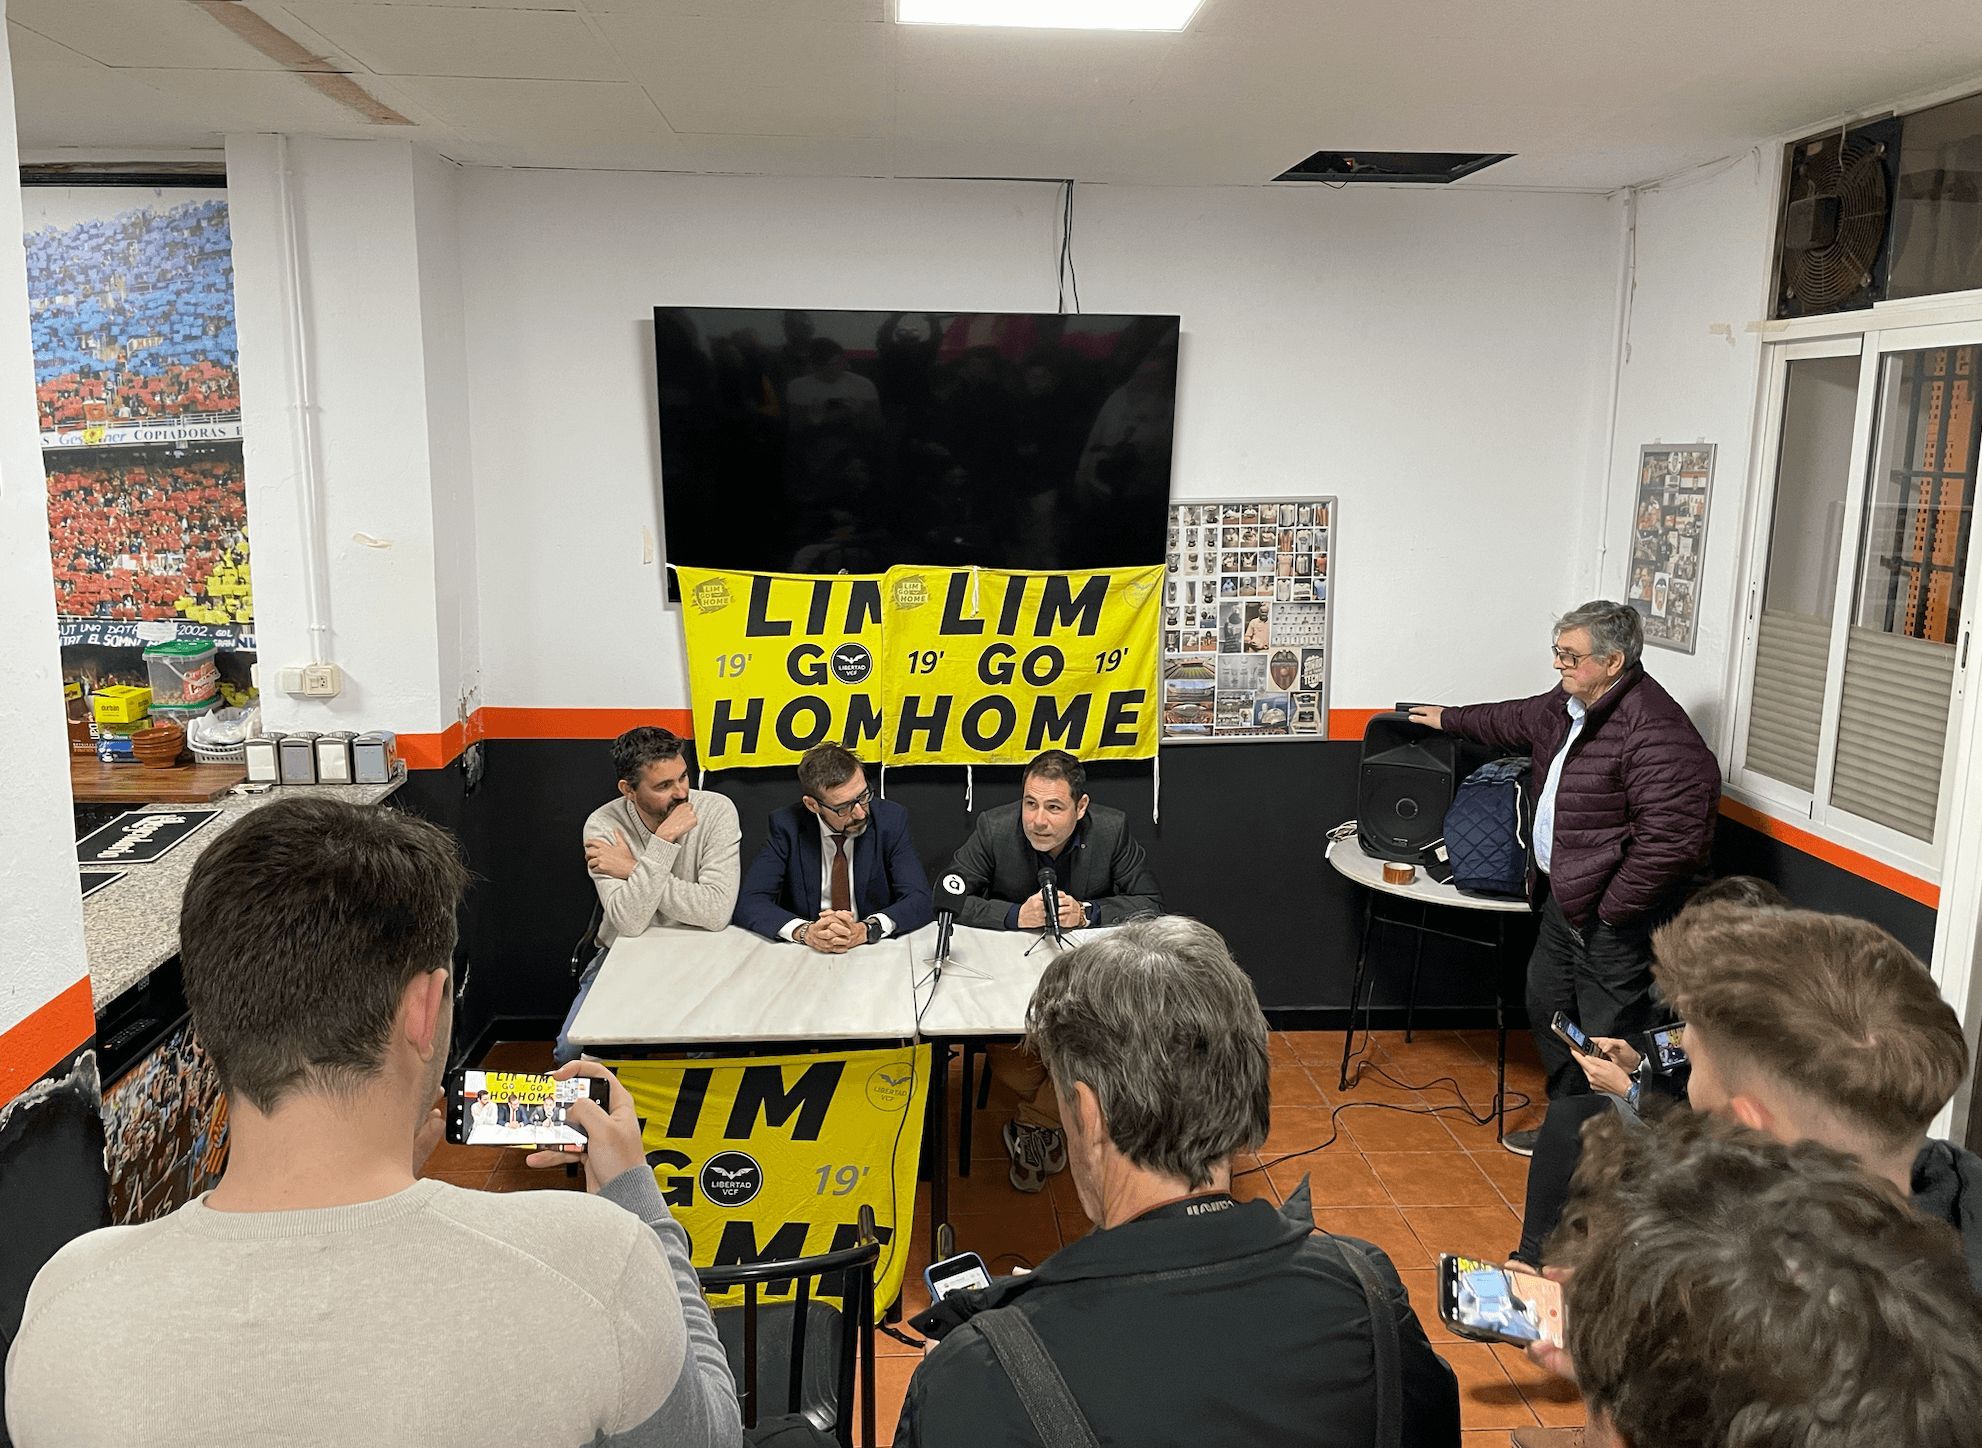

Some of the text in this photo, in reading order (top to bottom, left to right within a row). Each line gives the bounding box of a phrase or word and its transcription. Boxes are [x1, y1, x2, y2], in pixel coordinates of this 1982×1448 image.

[133, 428, 227, 442] COPIADORAS
[940, 573, 1111, 636] LIM
[716, 653, 753, 678] 19'
[908, 642, 1129, 686] 19' GO 19'
[709, 694, 882, 757] HOM
[895, 689, 1146, 754] HOME
[642, 1061, 847, 1142] IM
[873, 1086, 908, 1097] LIBERTAD
[711, 1180, 752, 1189] LIBERTAD
[722, 1188, 739, 1196] VCF
[816, 1164, 870, 1196] 19'
